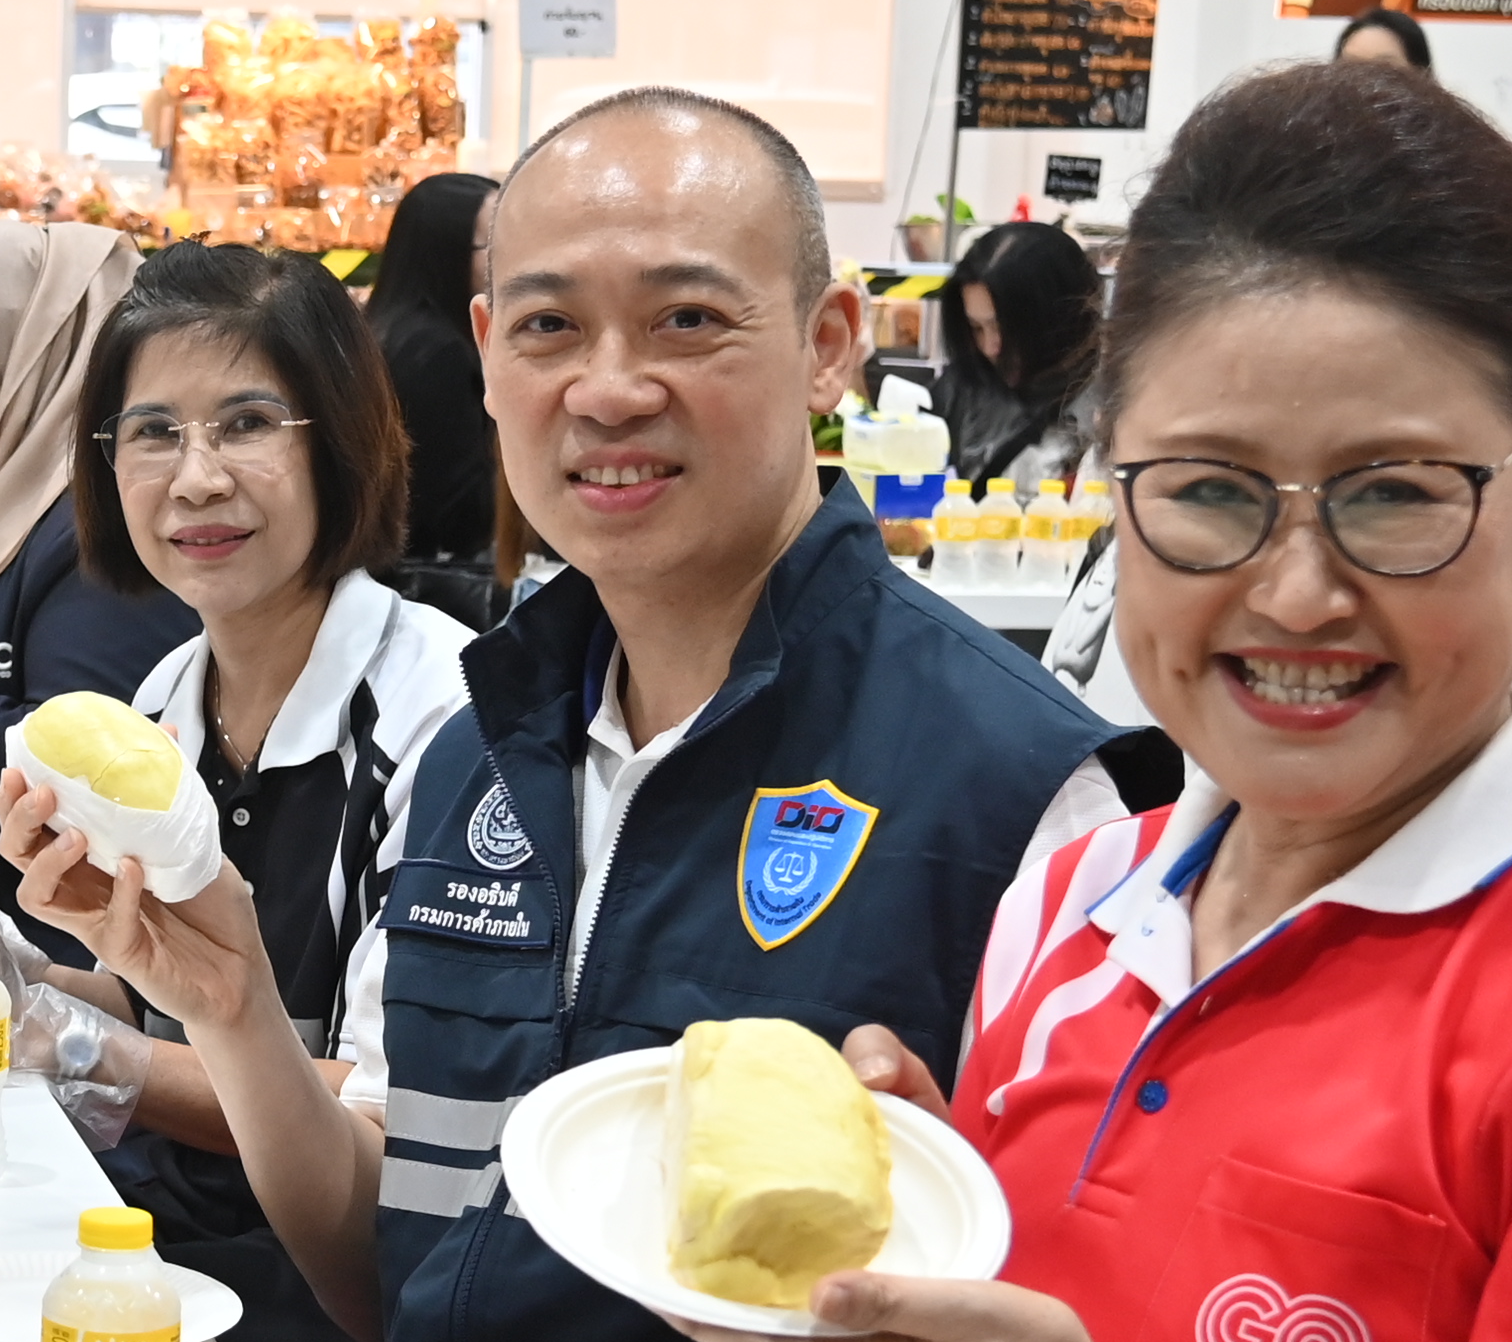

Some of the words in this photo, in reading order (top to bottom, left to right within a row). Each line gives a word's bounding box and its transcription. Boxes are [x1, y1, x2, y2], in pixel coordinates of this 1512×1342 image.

[446, 881, 522, 907] รองอธิบดี
[408, 904, 531, 938] กรมการค้าภายใน
